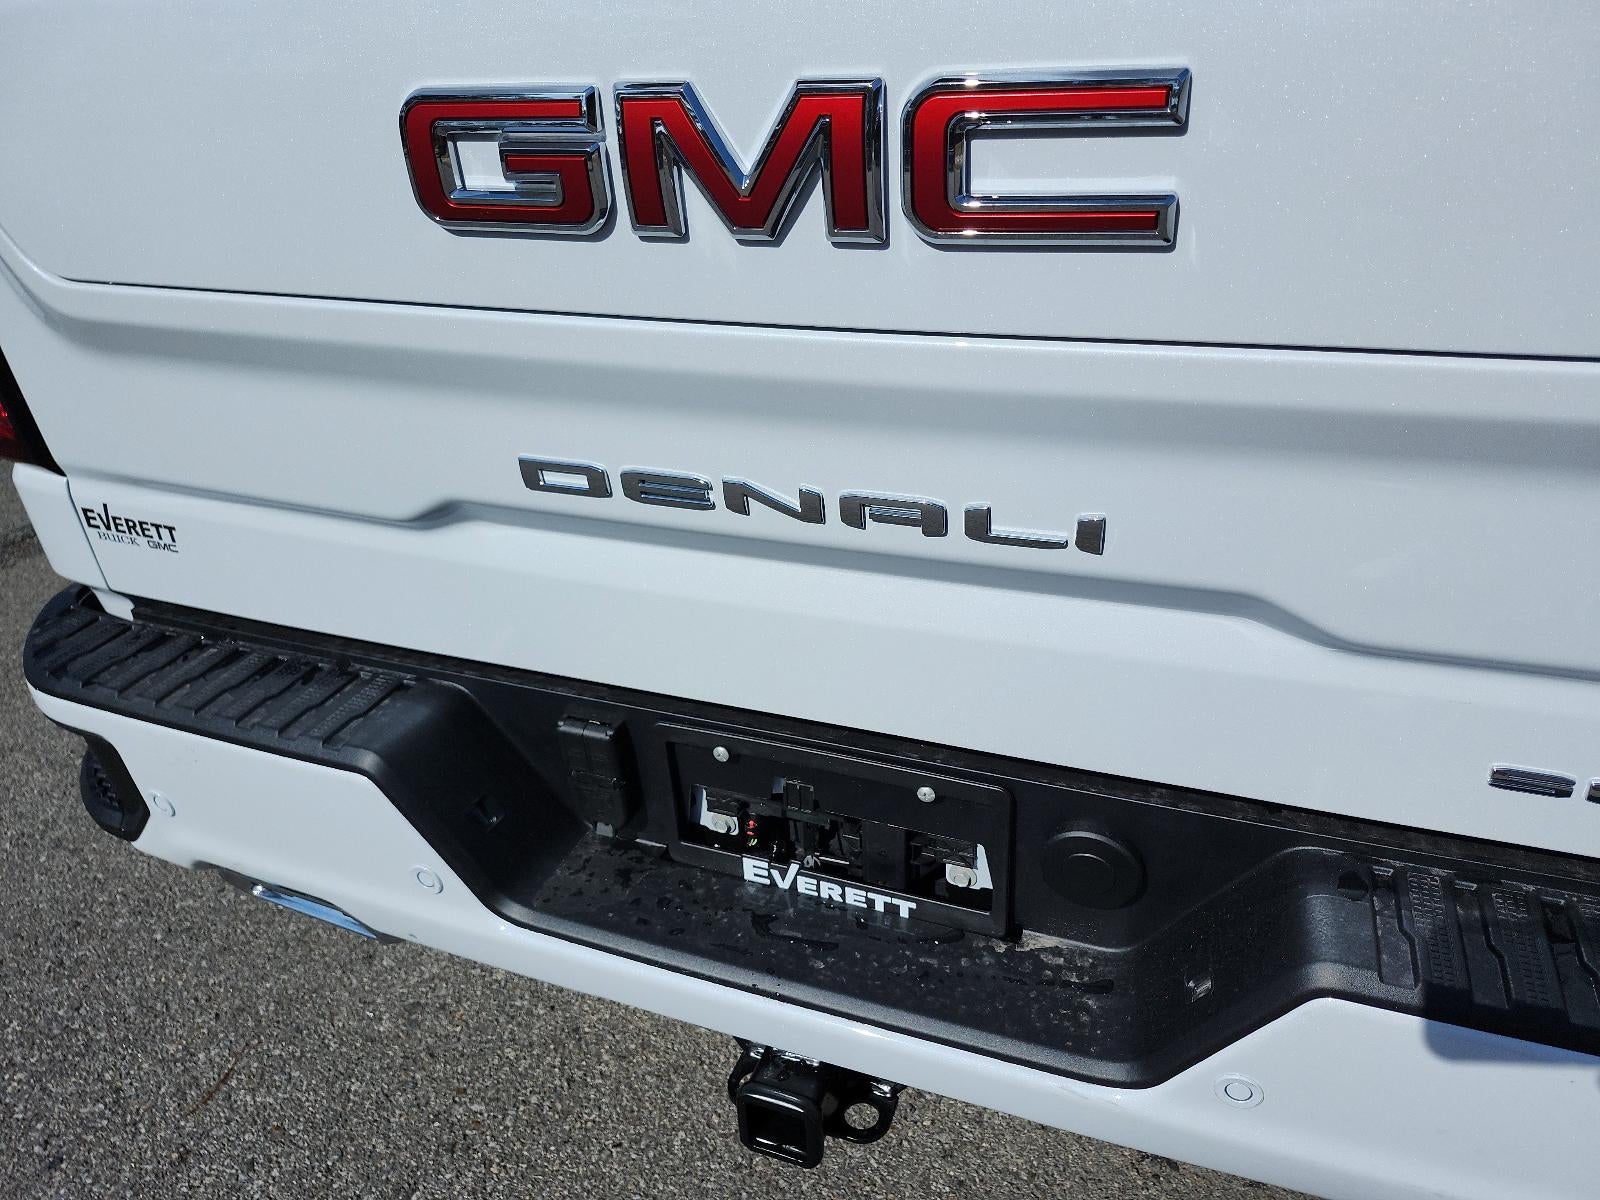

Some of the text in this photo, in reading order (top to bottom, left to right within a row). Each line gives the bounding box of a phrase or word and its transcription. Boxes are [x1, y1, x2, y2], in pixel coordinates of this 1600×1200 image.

[399, 67, 1192, 249] GMC
[81, 503, 177, 543] EVERETT
[517, 454, 1106, 556] DENALI
[97, 530, 179, 553] BUICK GMC
[742, 857, 917, 919] EVERETT
